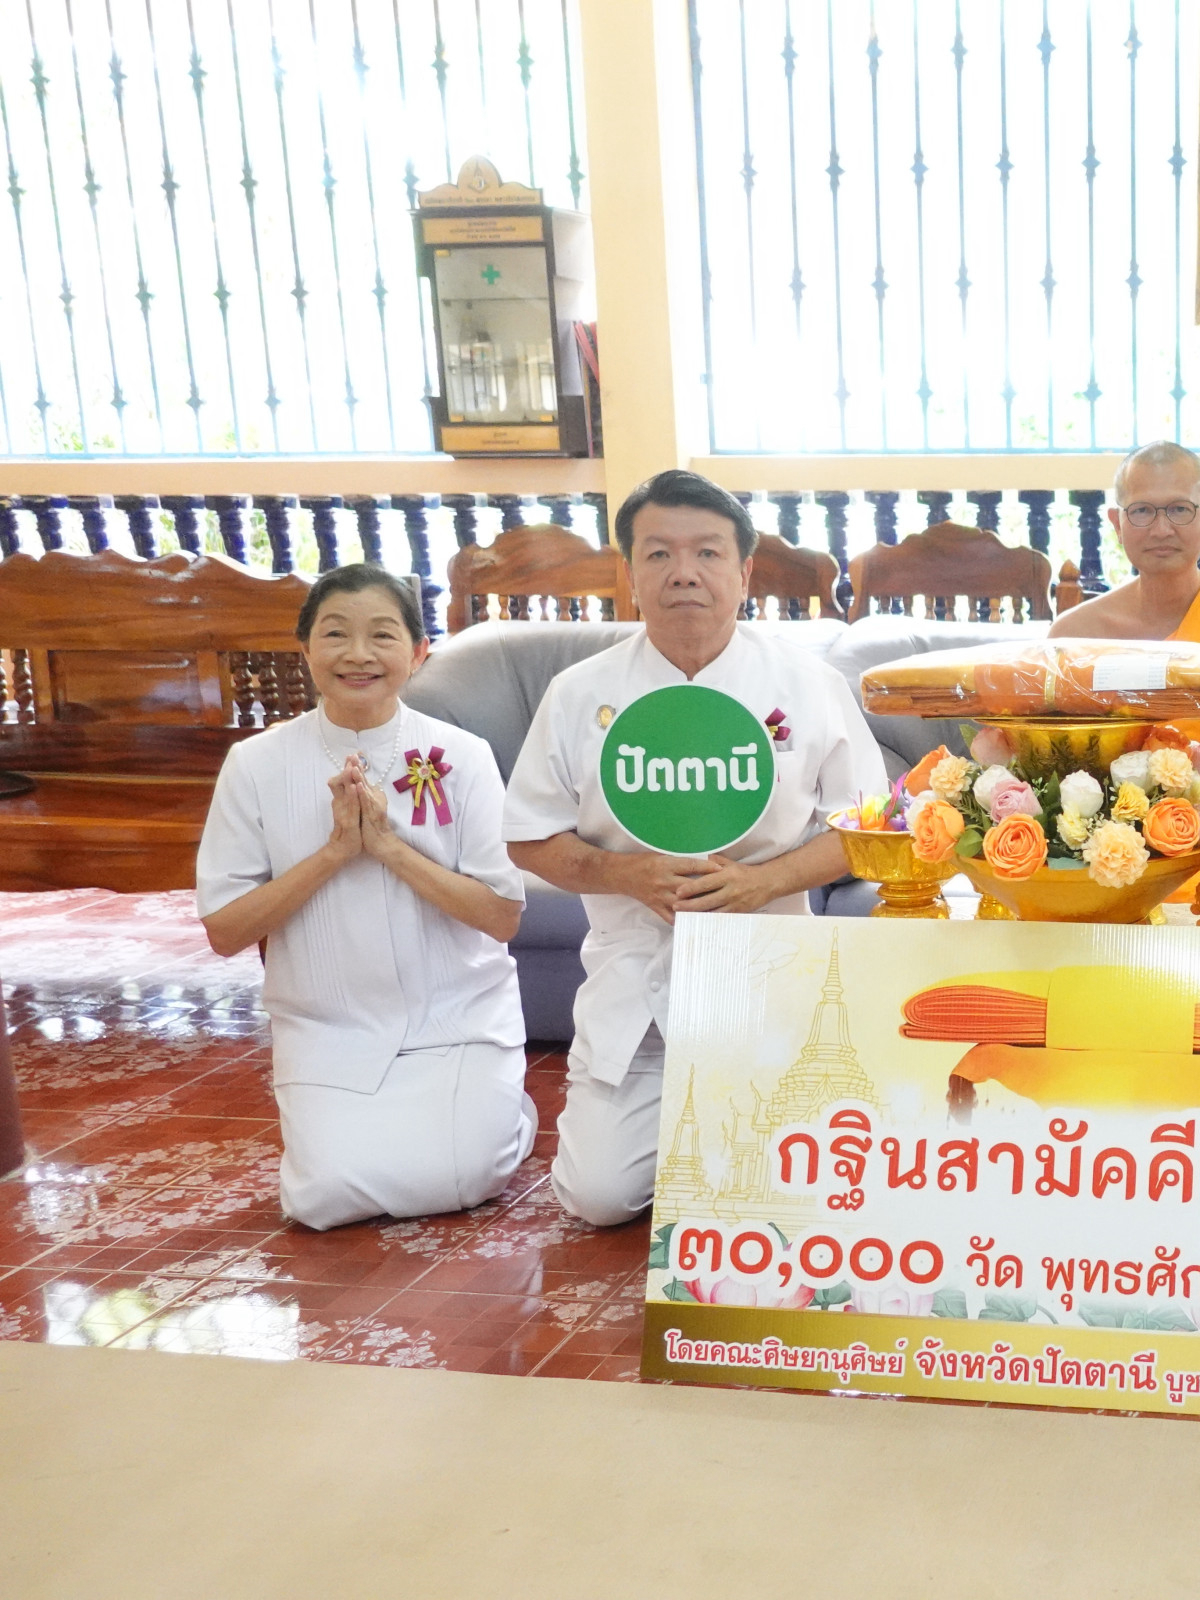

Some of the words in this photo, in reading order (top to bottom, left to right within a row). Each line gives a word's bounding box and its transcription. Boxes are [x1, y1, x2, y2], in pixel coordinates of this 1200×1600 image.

[616, 742, 760, 793] ปัตตานี
[678, 1227, 944, 1288] ๓๐,๐๐๐
[966, 1236, 1024, 1289] วัด
[665, 1331, 906, 1380] โดยคณะศิษยานุศิษย์
[915, 1338, 1157, 1391] จังหวัดปัตตานี
